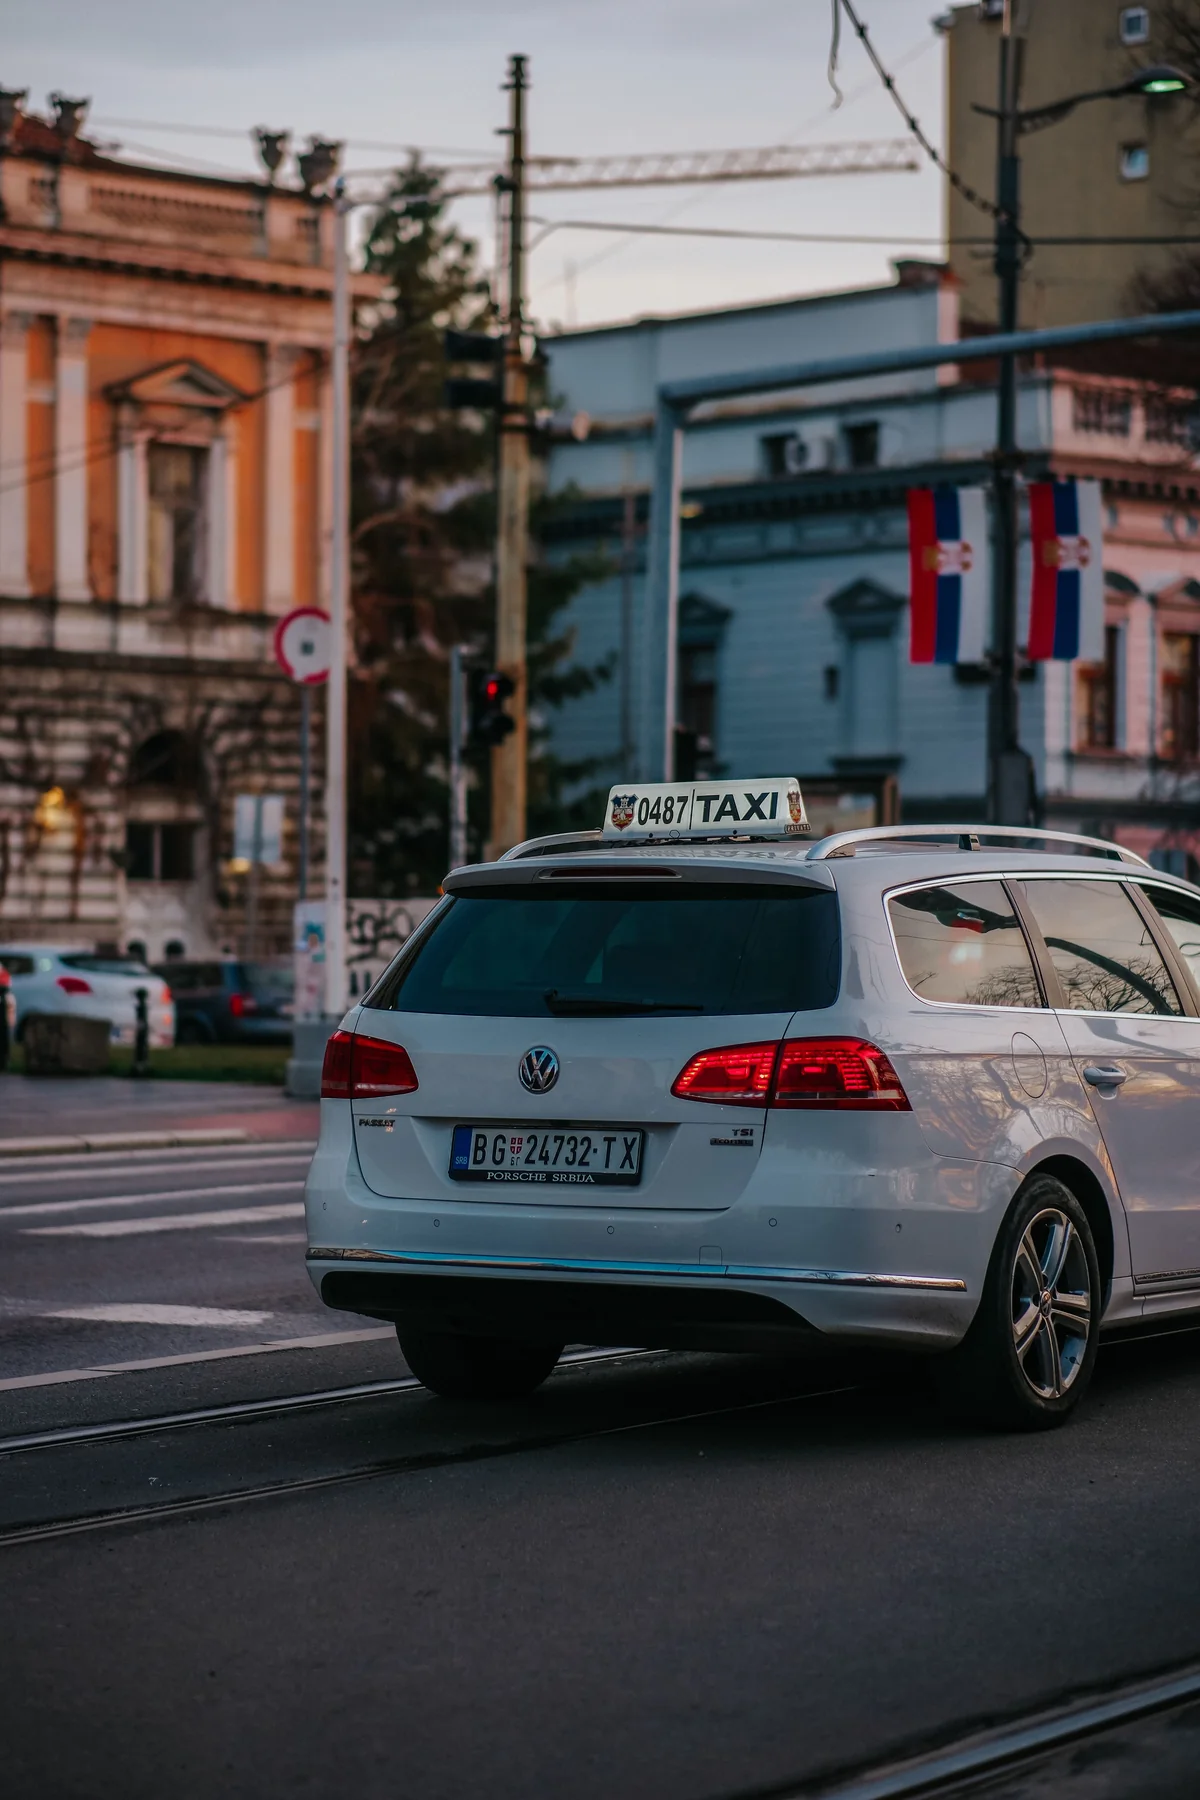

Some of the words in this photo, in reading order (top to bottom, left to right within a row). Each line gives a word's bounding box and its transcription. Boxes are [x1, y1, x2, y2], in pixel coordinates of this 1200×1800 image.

[637, 795, 689, 826] 0487
[696, 791, 779, 823] TAXI
[520, 1047, 559, 1092] VW
[359, 1119, 395, 1127] PASSAT
[732, 1128, 754, 1137] TSI
[472, 1133, 507, 1166] BG
[455, 1156, 468, 1165] SRB
[486, 1171, 547, 1181] PORSCHE
[552, 1173, 595, 1183] SRBIJA
